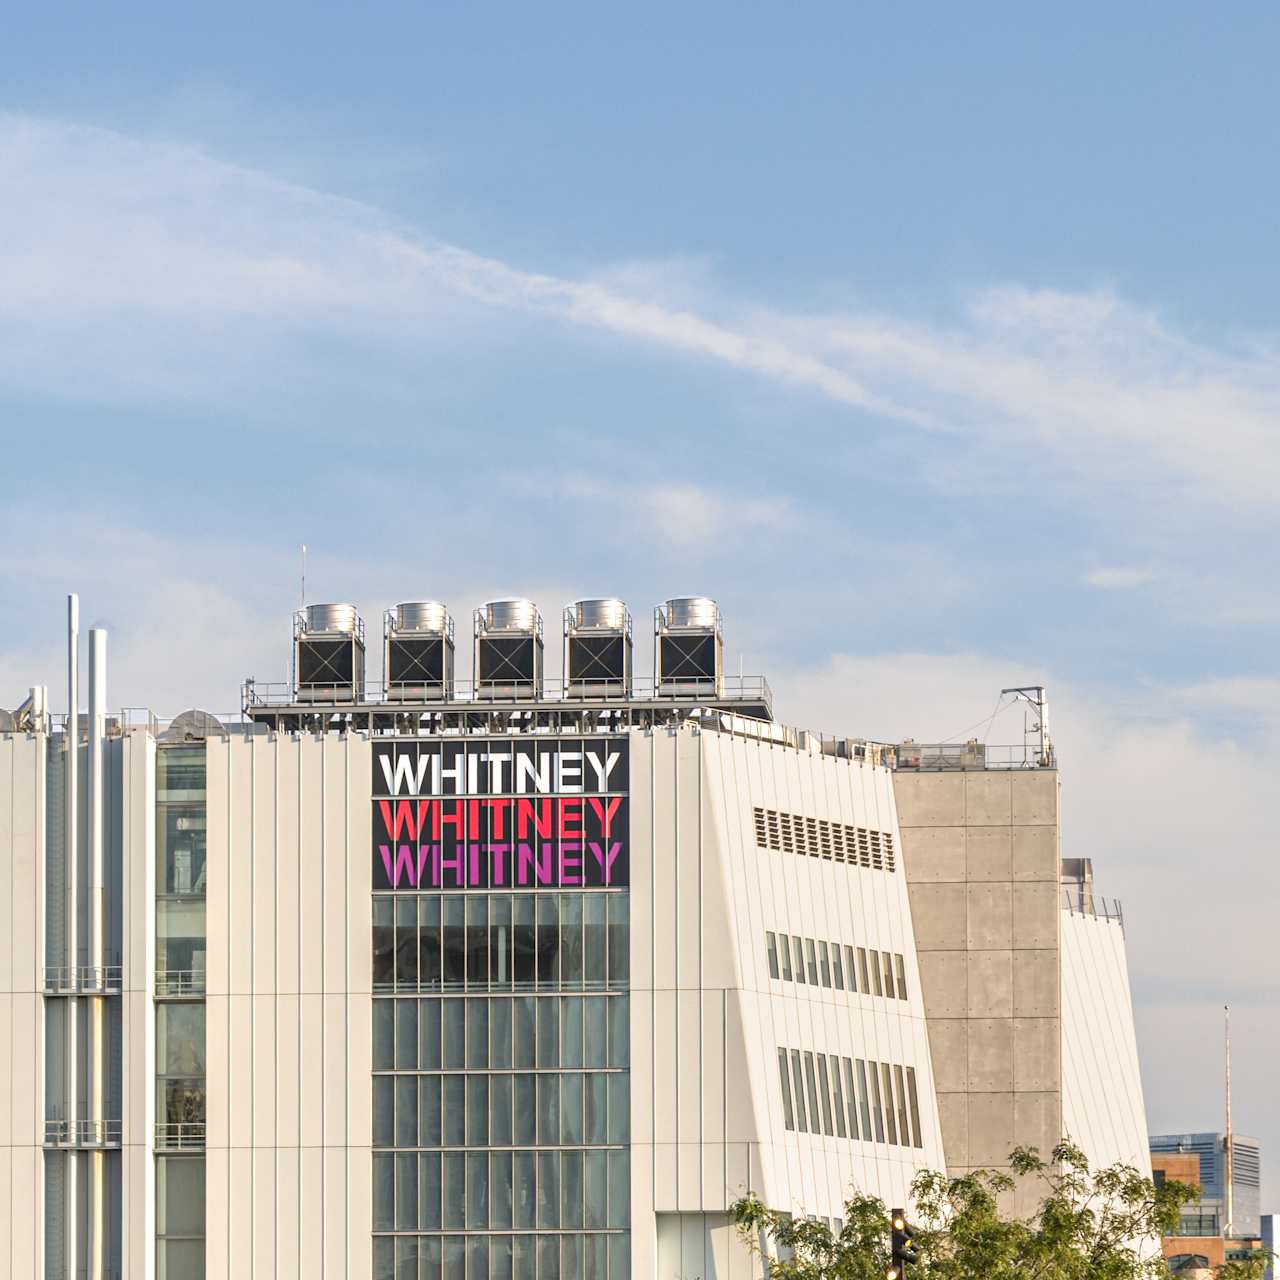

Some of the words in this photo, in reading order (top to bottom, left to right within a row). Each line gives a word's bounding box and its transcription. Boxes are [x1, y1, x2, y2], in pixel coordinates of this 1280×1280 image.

[378, 752, 620, 795] WHITNEY
[378, 798, 623, 841] WHITNEY
[378, 842, 623, 887] WHITNEY
